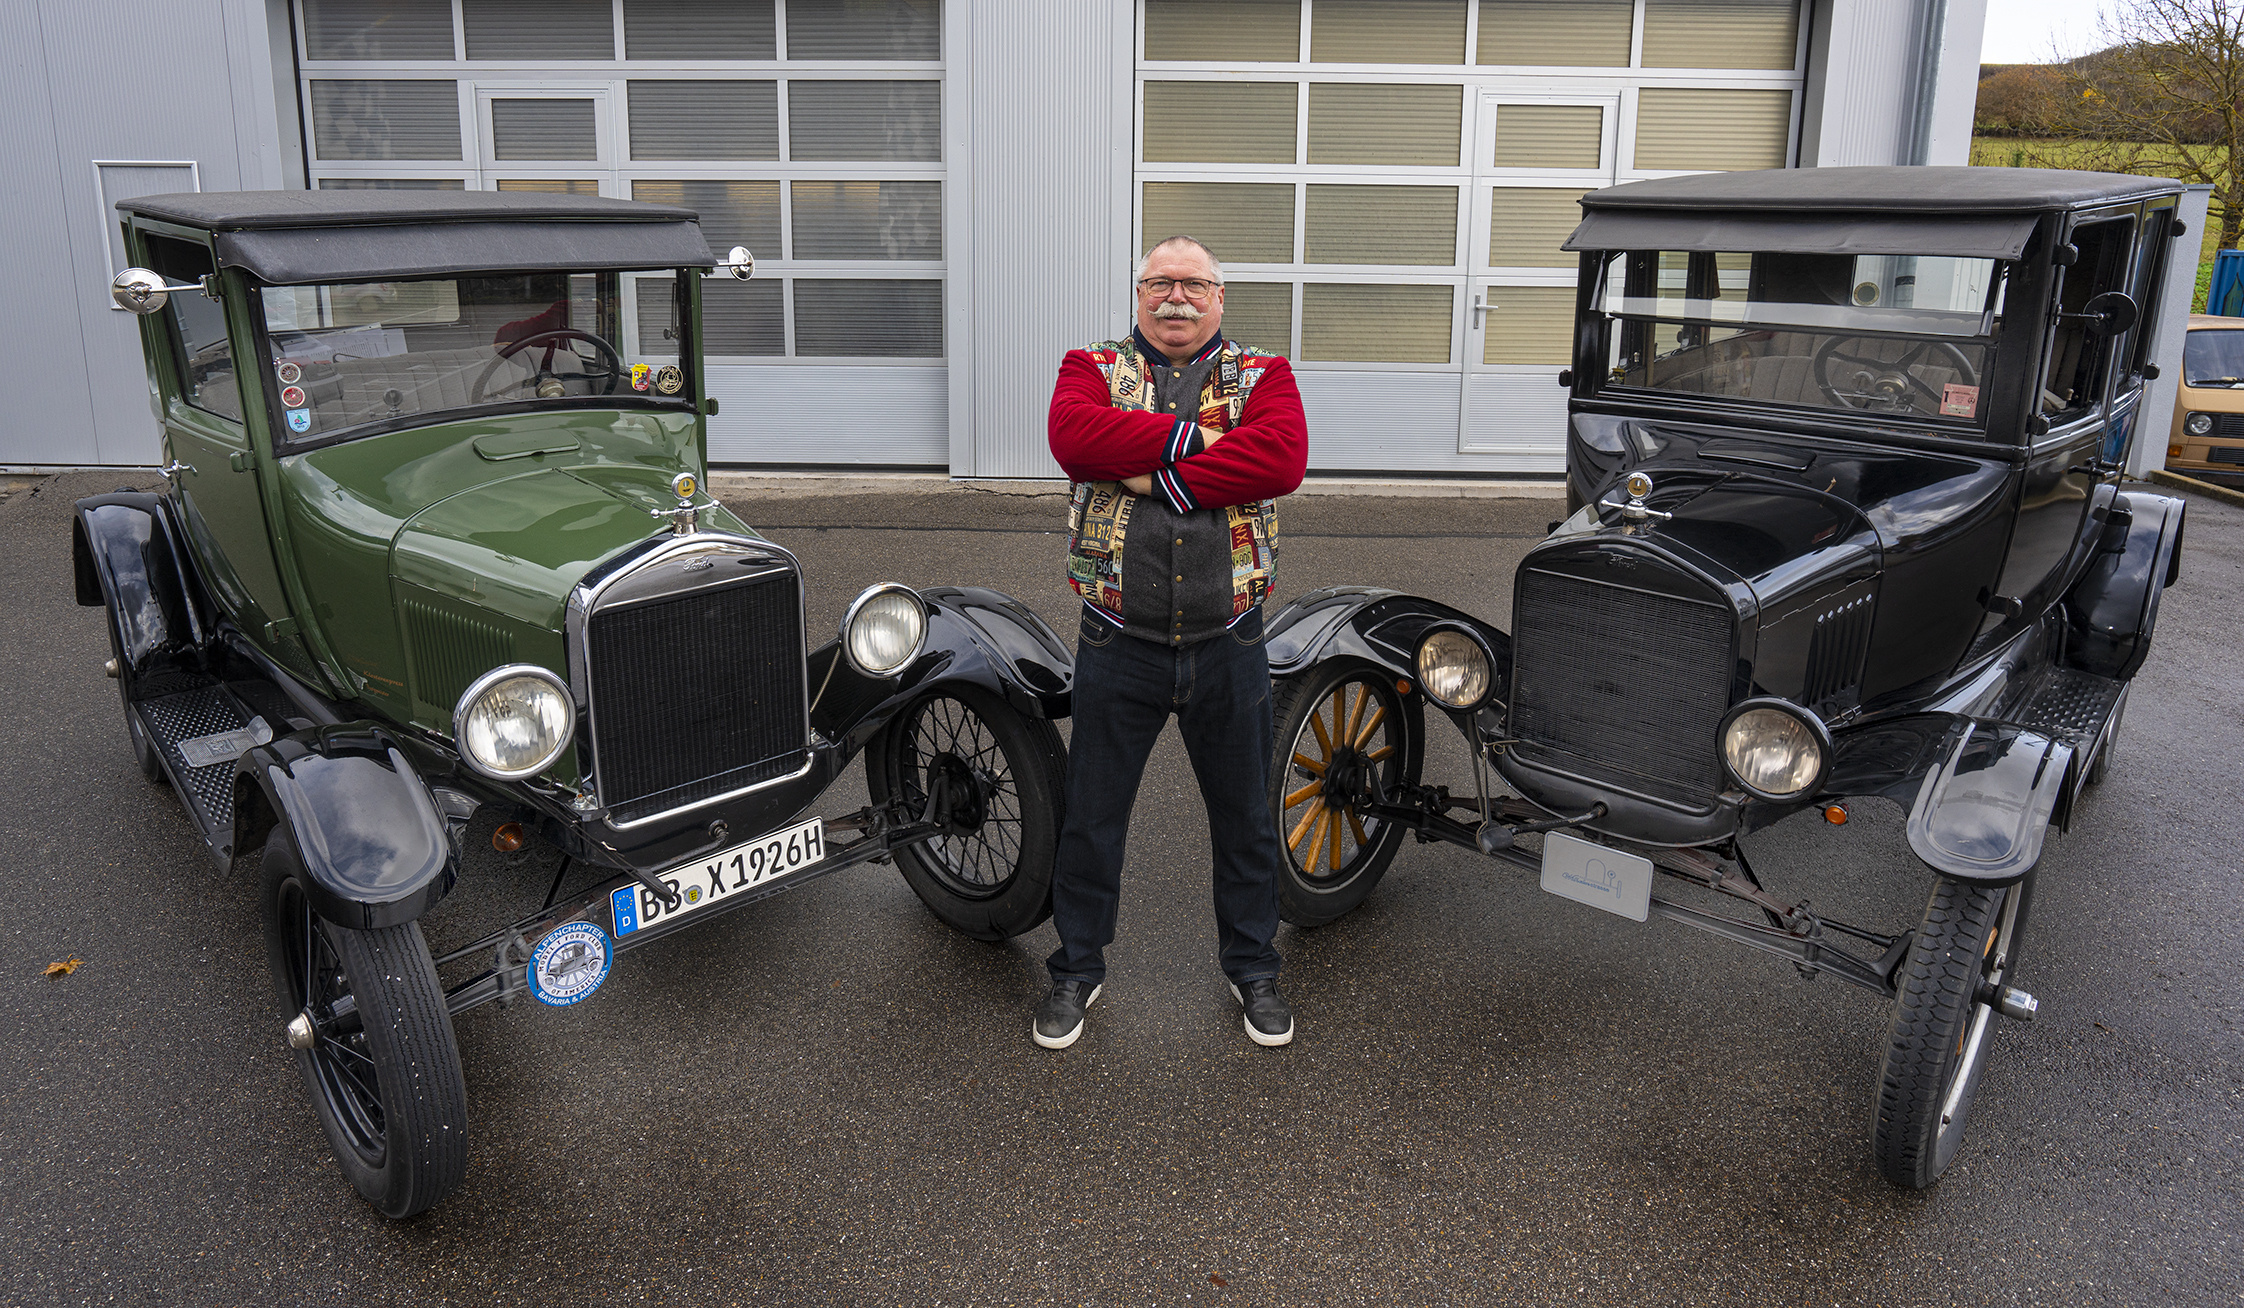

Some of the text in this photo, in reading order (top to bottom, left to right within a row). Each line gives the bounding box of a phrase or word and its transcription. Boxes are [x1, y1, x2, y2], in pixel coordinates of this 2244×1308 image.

[1119, 375, 1137, 398] 486
[1092, 490, 1111, 514] 486
[1097, 523, 1111, 541] B12
[706, 861, 726, 898] X
[730, 825, 821, 889] 1926H
[622, 916, 631, 927] D
[533, 923, 605, 961] ALPENCHAPTER
[538, 946, 555, 972] MODEL
[565, 933, 586, 942] FORD
[588, 936, 602, 951] CLUB
[537, 969, 608, 1005] BAVARIA & AUSTRIA
[563, 974, 596, 996] AMERICA
